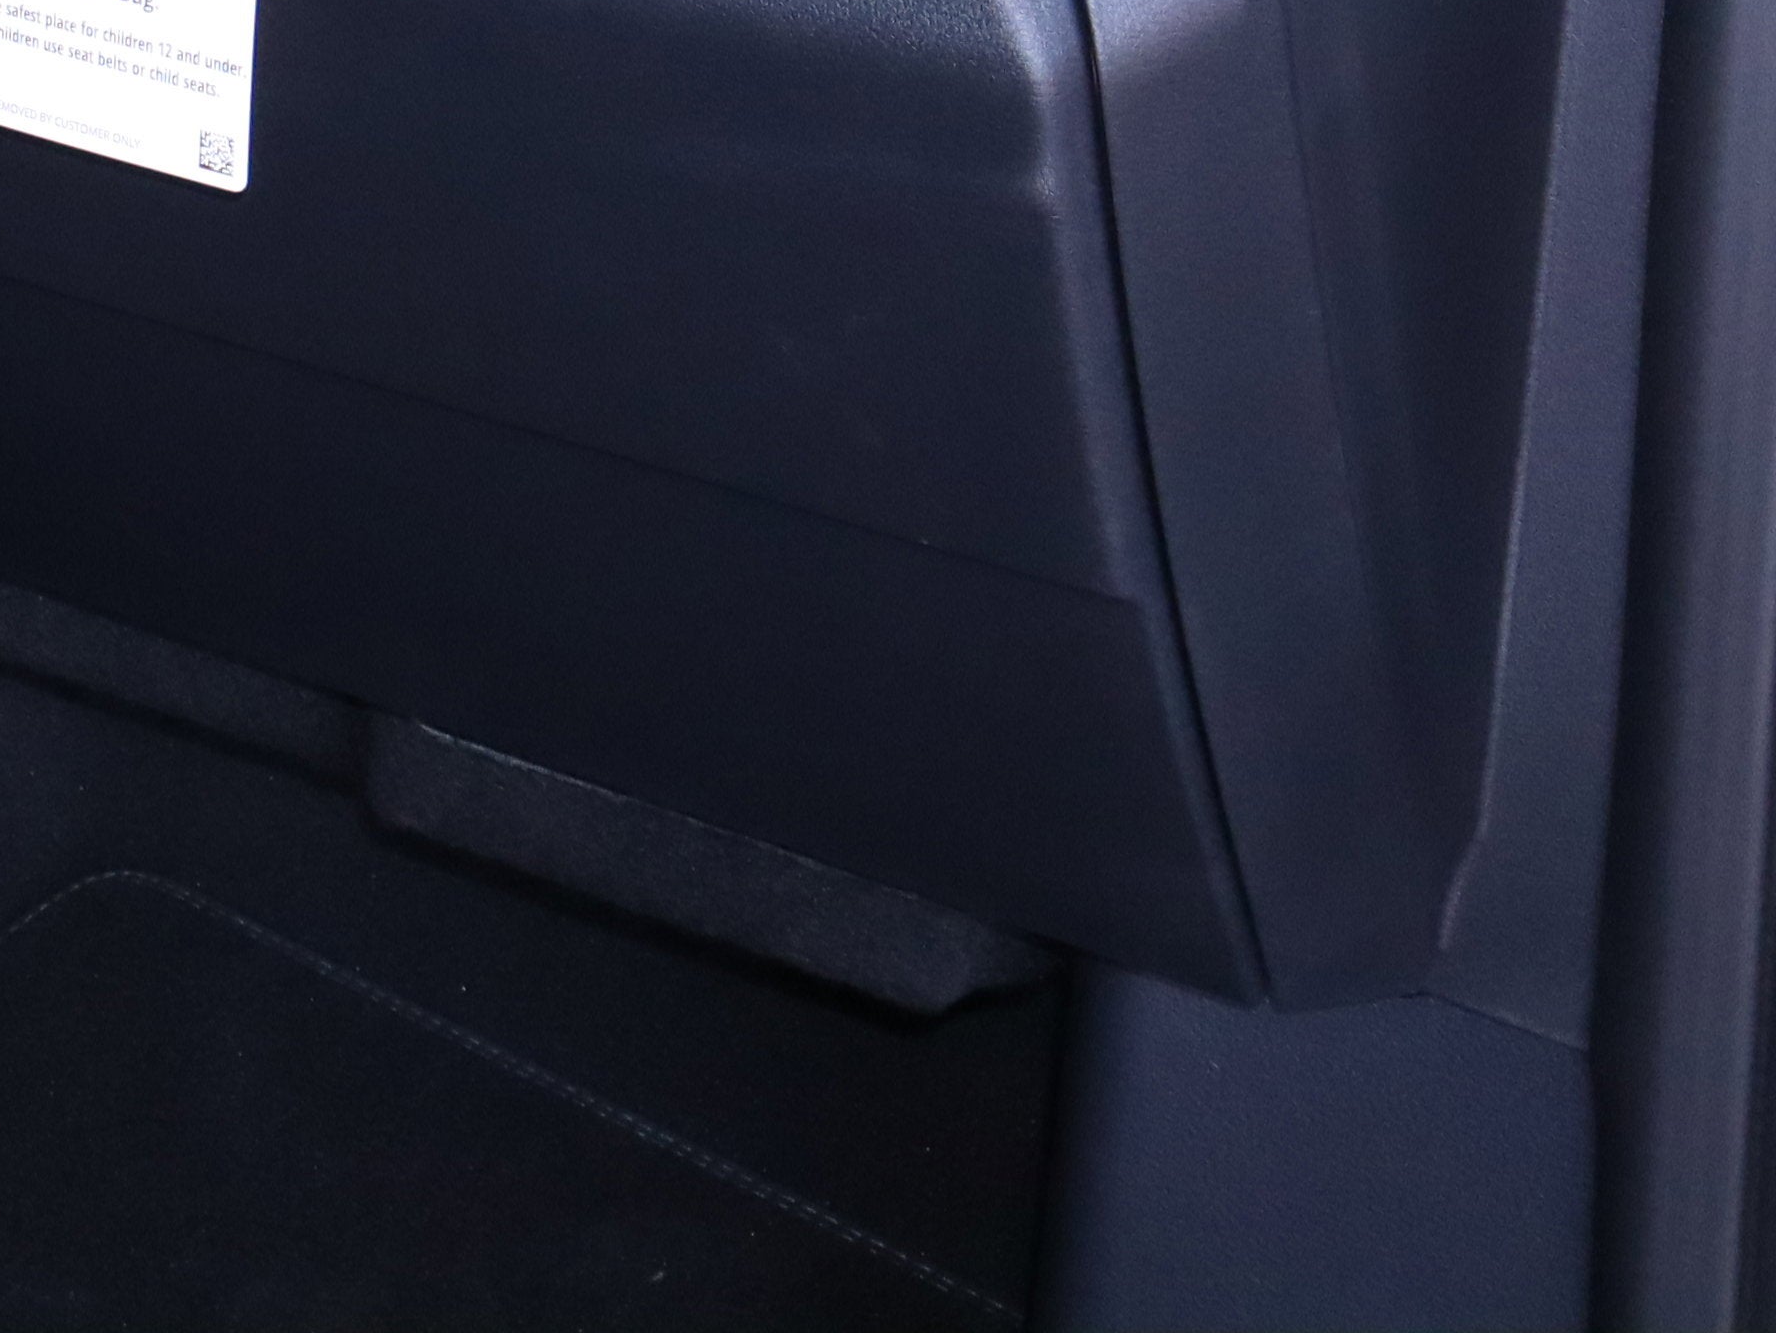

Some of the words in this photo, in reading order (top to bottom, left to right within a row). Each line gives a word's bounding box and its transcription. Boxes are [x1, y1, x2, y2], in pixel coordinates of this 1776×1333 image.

[5, 4, 42, 24] safest
[44, 15, 77, 33] place
[80, 21, 99, 38] for
[102, 29, 153, 52] children
[158, 42, 172, 58] 12
[175, 49, 201, 66] and
[204, 58, 247, 76] under.
[42, 40, 64, 55] use
[67, 47, 94, 64] seat
[97, 53, 128, 72] belts
[131, 64, 144, 76] or
[148, 68, 180, 86] child
[183, 77, 220, 97] seats.
[39, 111, 54, 123] BY
[54, 116, 113, 142] CUSTOMER
[112, 132, 142, 149] ONLY
